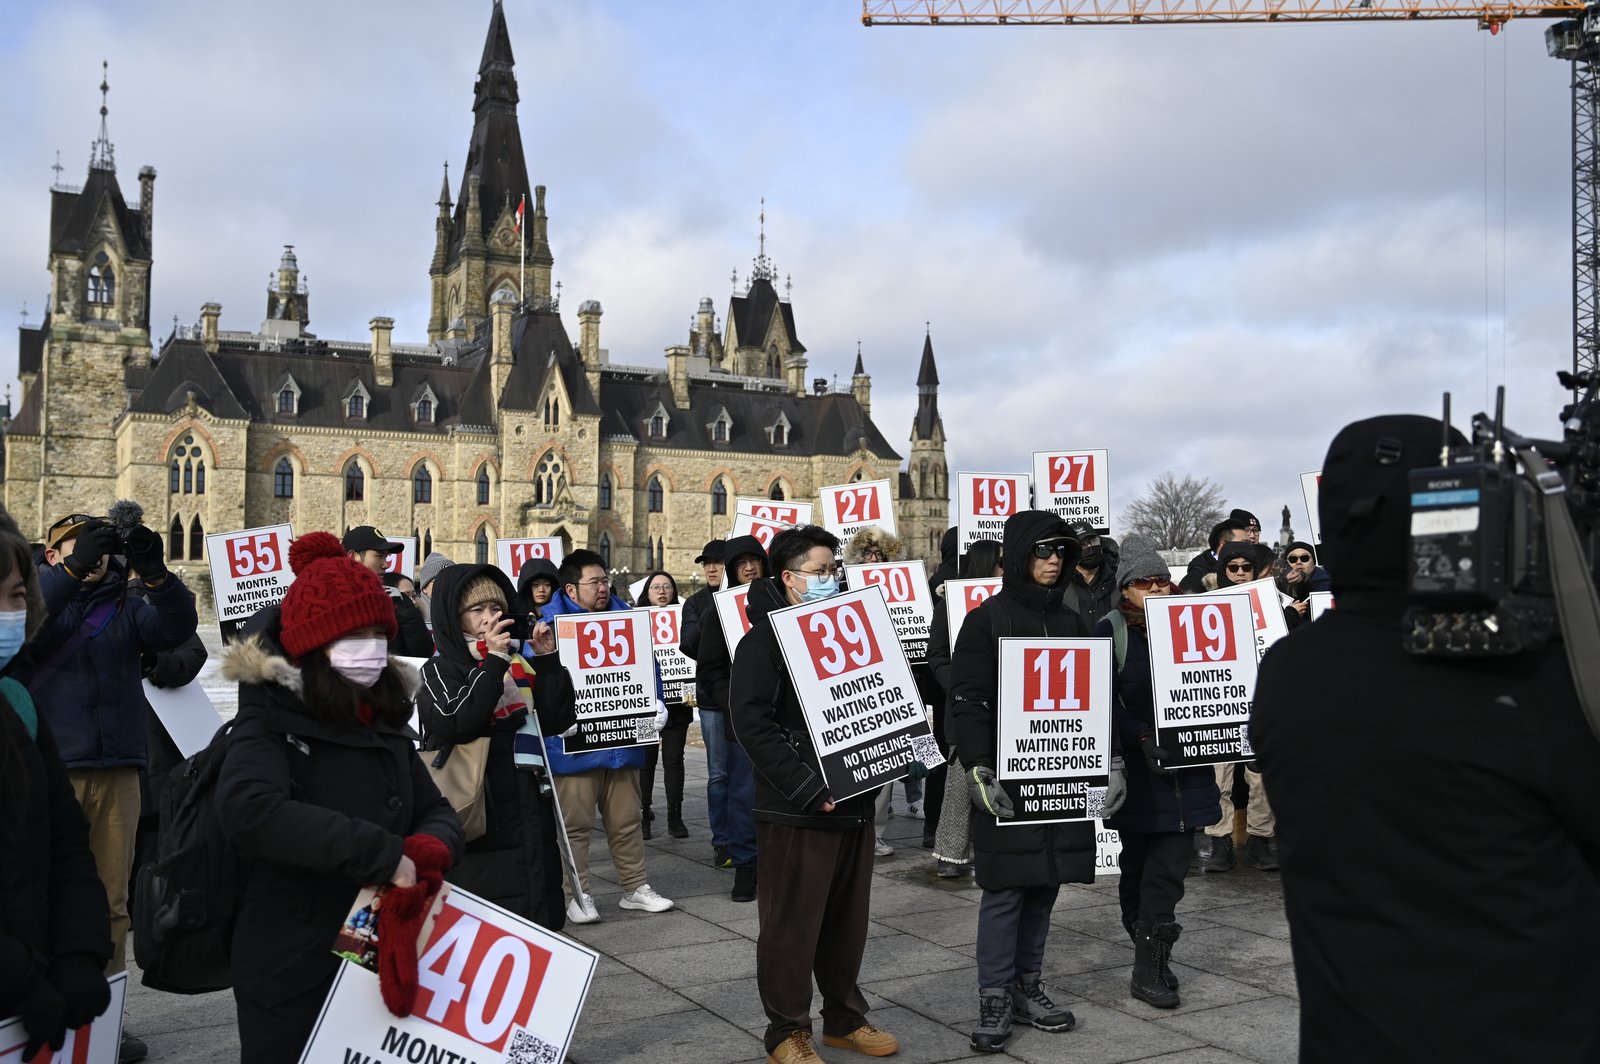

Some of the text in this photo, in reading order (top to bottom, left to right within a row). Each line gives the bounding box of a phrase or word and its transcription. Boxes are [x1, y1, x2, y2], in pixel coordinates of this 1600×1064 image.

[1054, 456, 1089, 492] 27
[840, 487, 873, 523] 27
[978, 479, 1011, 516] 19
[1054, 495, 1090, 506] MONTHS
[1083, 505, 1100, 515] FOR
[977, 520, 1006, 529] MONTH
[755, 525, 776, 551] 2
[968, 530, 1004, 540] WAITING
[232, 535, 276, 576] 55
[236, 576, 278, 592] MONTHS
[868, 568, 910, 602] 30
[227, 588, 269, 604] WAITING
[223, 598, 284, 617] IRCC RESPON
[890, 606, 914, 616] NTHS
[651, 611, 674, 644] 8
[908, 616, 926, 625] FOR
[809, 604, 872, 675] 39
[897, 626, 931, 637] SPONSE
[1178, 604, 1227, 661] 19
[583, 619, 630, 668] 35
[654, 648, 676, 658] NTHS
[669, 657, 686, 666] FOR
[585, 671, 631, 685] MONTHS
[1033, 650, 1081, 710] 11
[1181, 668, 1232, 685] MONTHS
[575, 684, 643, 701] WAITING FOR
[829, 671, 885, 702] MONTHS
[1170, 684, 1247, 703] WAITING FOR
[574, 697, 650, 715] RCC RESPONSE
[822, 686, 904, 725] WAITING FOR
[1164, 707, 1191, 721] IRCC
[581, 722, 594, 733] NO
[821, 702, 917, 747] IRCC RESPONSE
[1029, 719, 1083, 734] MONTHS
[586, 729, 638, 743] NO RESULTS
[1178, 731, 1193, 743] NO
[843, 733, 912, 769] NO TIMELINES
[1016, 737, 1096, 753] WAITING FOR
[1183, 741, 1241, 757] NO RESULTS
[852, 750, 914, 783] NO RESULTS
[1007, 755, 1102, 772] IRCC RESPONSE
[1020, 782, 1090, 797] NO TIMELINES
[1024, 797, 1086, 812] NO RESULTS
[418, 913, 532, 1044] 40
